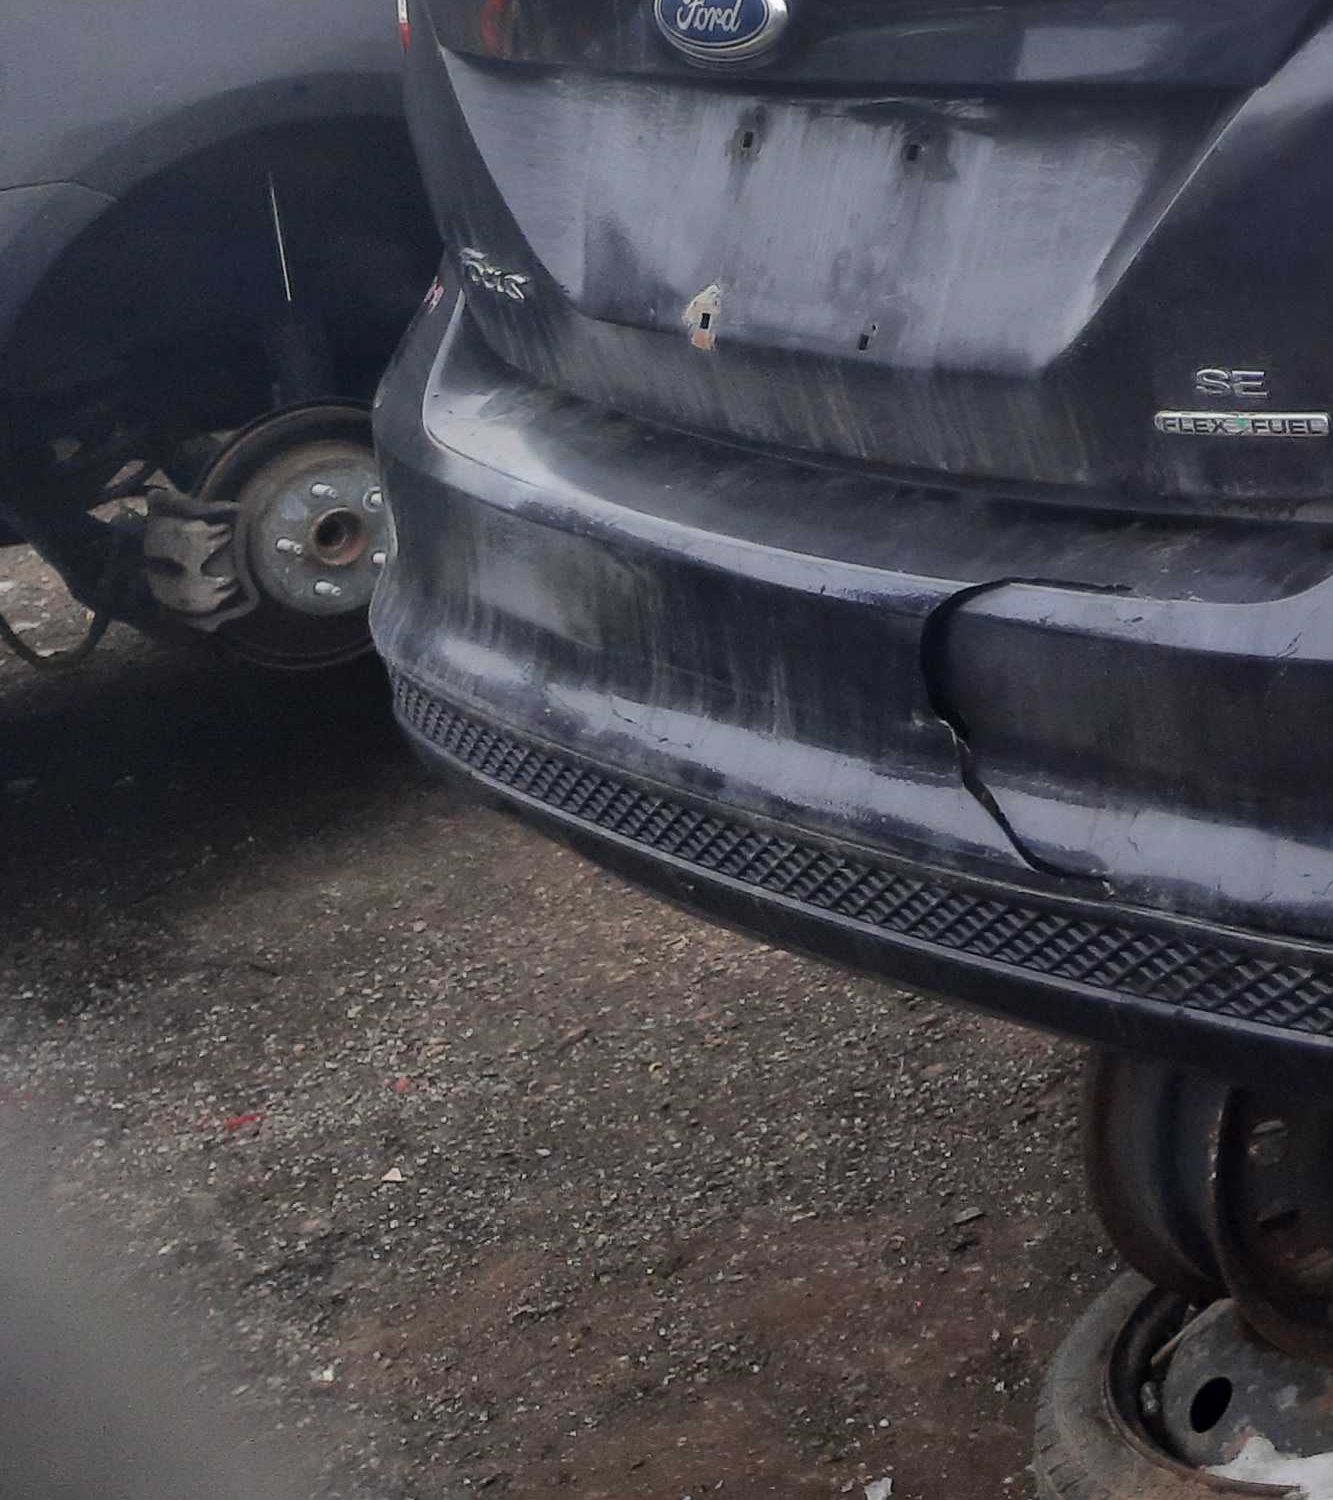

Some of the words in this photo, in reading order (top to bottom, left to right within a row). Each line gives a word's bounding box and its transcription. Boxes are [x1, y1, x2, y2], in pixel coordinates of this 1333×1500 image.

[1195, 368, 1270, 399] SE
[1162, 416, 1229, 435] FLEX
[1251, 417, 1324, 436] FUEL
